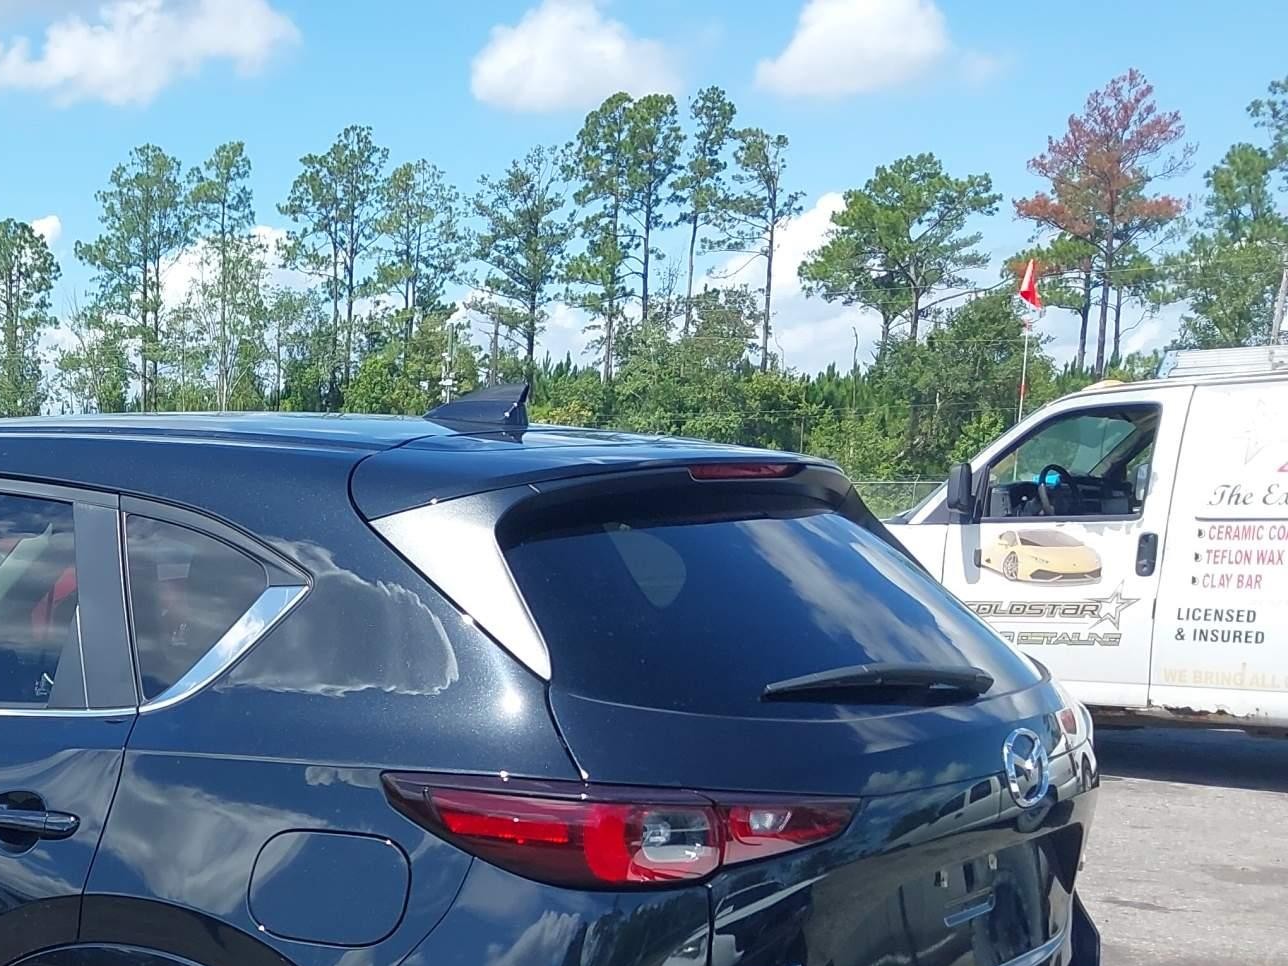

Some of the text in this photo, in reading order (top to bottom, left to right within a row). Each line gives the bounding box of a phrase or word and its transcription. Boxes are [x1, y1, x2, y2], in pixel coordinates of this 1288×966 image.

[1207, 484, 1253, 506] The
[1208, 525, 1264, 541] CERAMIC
[1206, 549, 1285, 565] TEFLON WAX
[1202, 573, 1263, 590] CLAY BAR
[966, 601, 1101, 618] OLDSTAR
[1176, 607, 1257, 623] LICENSED
[1174, 627, 1265, 644] & INSURED
[1163, 667, 1188, 683] WE
[1192, 668, 1245, 686] BRING
